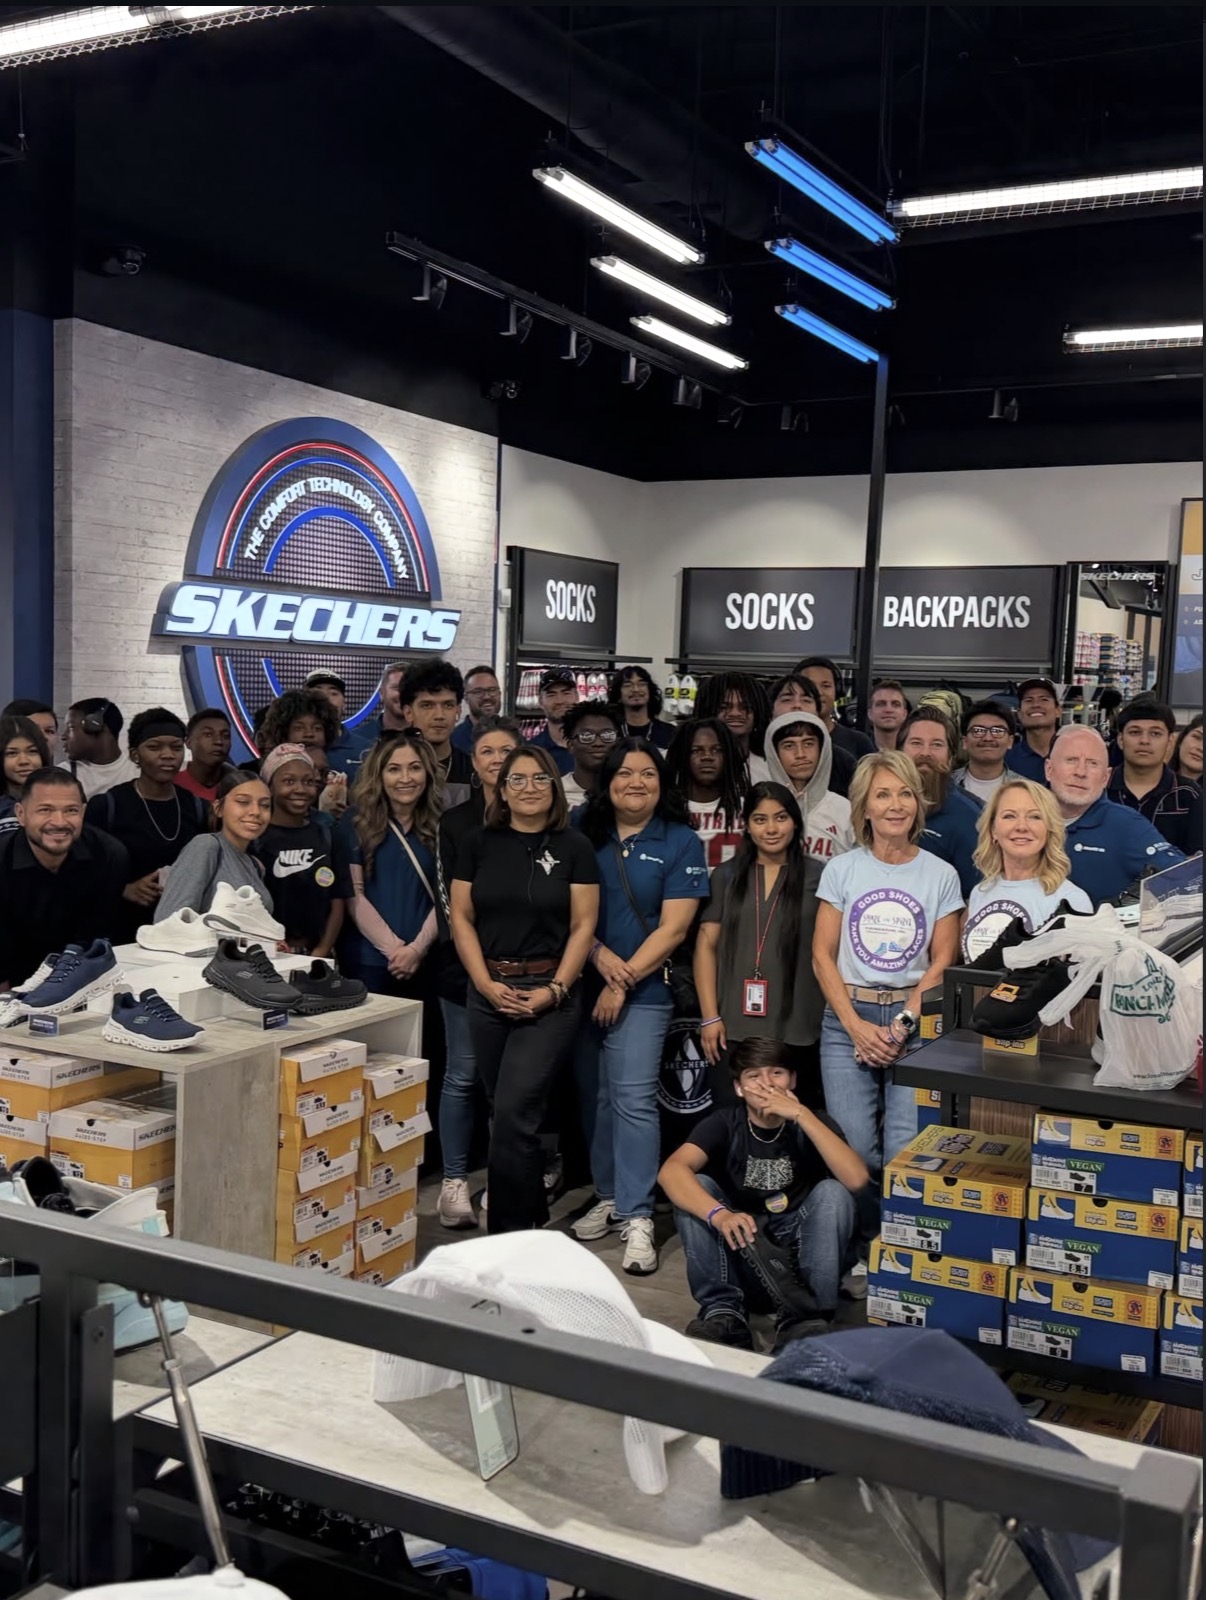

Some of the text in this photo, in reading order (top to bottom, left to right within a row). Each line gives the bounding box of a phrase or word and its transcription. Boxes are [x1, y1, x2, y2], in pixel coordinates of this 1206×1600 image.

[244, 476, 409, 580] THE COMFORT TECHNOLOGY COMPANY
[546, 579, 596, 623] SOCKS
[166, 584, 461, 650] SKECHERS
[725, 592, 815, 631] SOCKS
[883, 596, 1030, 628] BACKPACKS
[280, 848, 314, 865] NIKE
[858, 891, 920, 914] GOOD SHOES
[974, 903, 999, 922] GOOD
[851, 921, 860, 944] TAKE
[856, 944, 870, 961] YOU
[905, 928, 924, 959] PLACES
[56, 1064, 102, 1080] SKECHERS
[76, 1128, 106, 1137] SKECHERS
[138, 1124, 176, 1141] SKECHER
[1069, 1160, 1102, 1172] VEGAN
[918, 1218, 950, 1230] VEGAN
[922, 1240, 938, 1250] 8.5
[1067, 1242, 1100, 1254] VEGAN
[1070, 1264, 1088, 1274] 8.5
[902, 1293, 932, 1306] VEGAN
[912, 1316, 918, 1325] 9
[1046, 1324, 1078, 1337] VEGAN
[1055, 1348, 1062, 1358] 9
